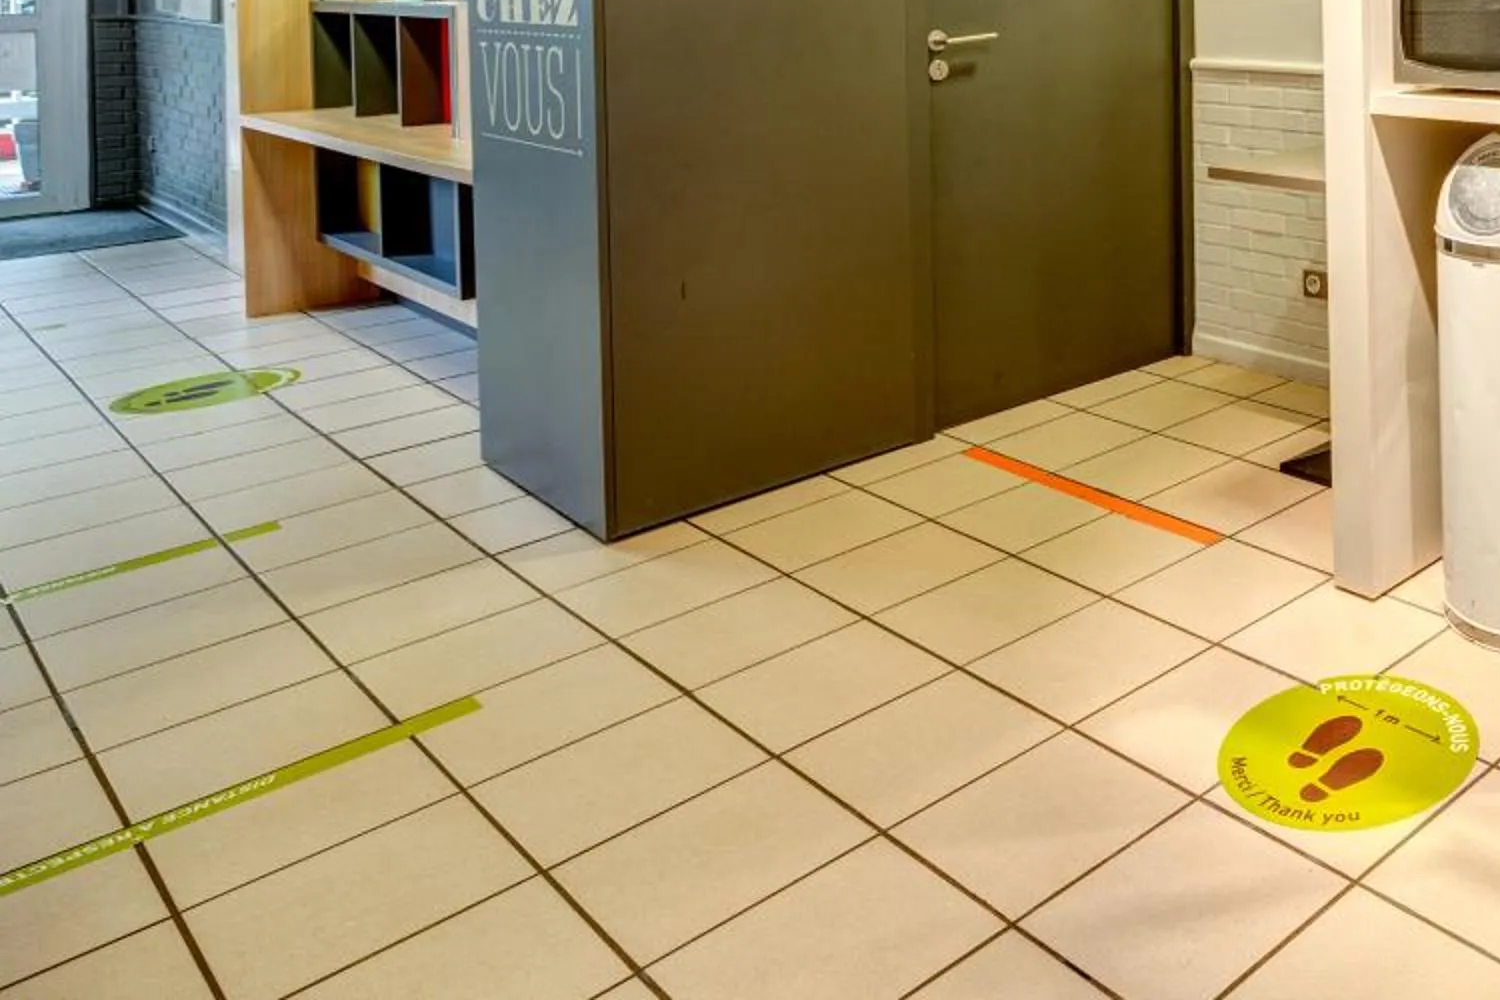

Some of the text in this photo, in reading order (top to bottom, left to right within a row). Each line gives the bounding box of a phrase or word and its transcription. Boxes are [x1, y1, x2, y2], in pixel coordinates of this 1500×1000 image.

[1261, 794, 1320, 823] Thank
[1322, 810, 1360, 825] you
[0, 832, 132, 888] RESPECTE
